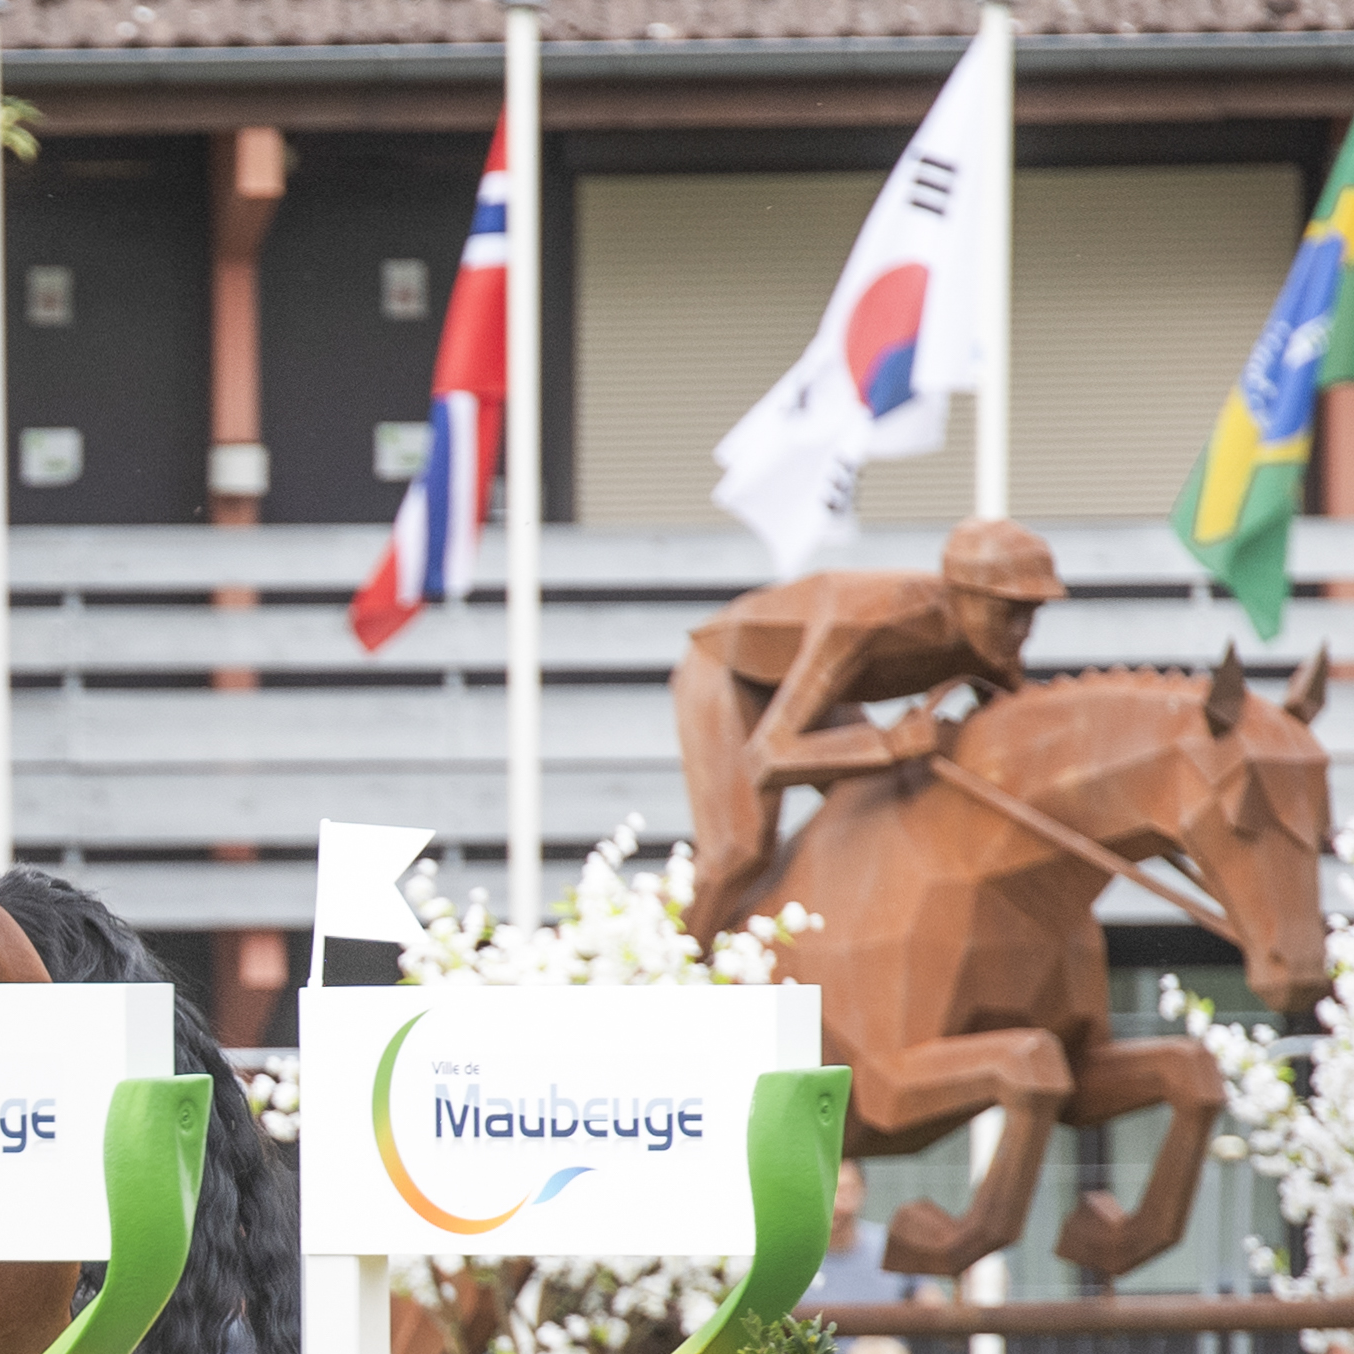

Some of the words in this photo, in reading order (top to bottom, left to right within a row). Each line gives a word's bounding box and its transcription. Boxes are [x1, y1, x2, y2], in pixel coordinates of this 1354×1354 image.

[432, 1061, 459, 1075] Ville
[464, 1061, 480, 1075] de
[435, 1083, 704, 1152] Maubeuge
